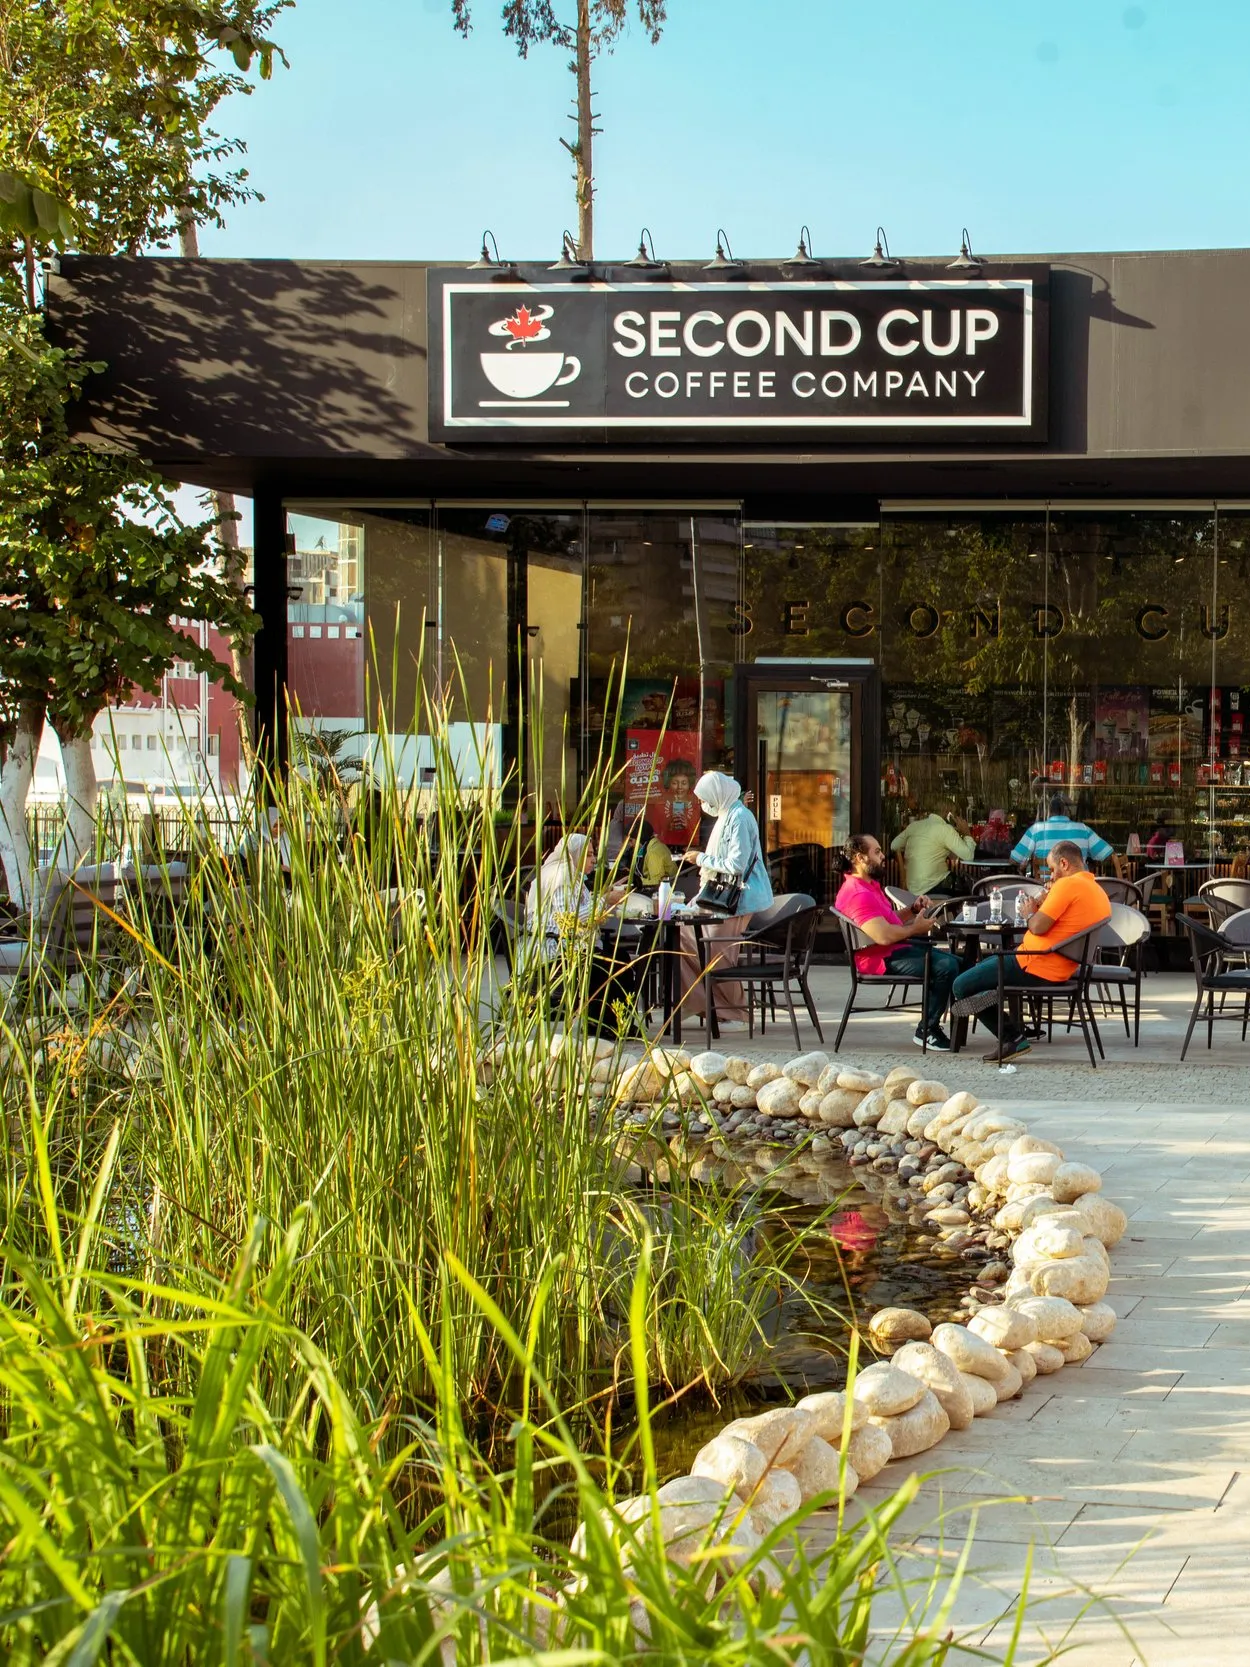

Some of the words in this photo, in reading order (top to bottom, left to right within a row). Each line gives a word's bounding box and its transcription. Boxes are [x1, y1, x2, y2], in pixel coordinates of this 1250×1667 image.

[612, 309, 861, 357] SECOND
[877, 308, 999, 357] CUP
[625, 371, 776, 398] COFFEE
[791, 370, 985, 398] COMPANY
[727, 600, 1065, 641] SECOND
[1152, 688, 1177, 696] POWER
